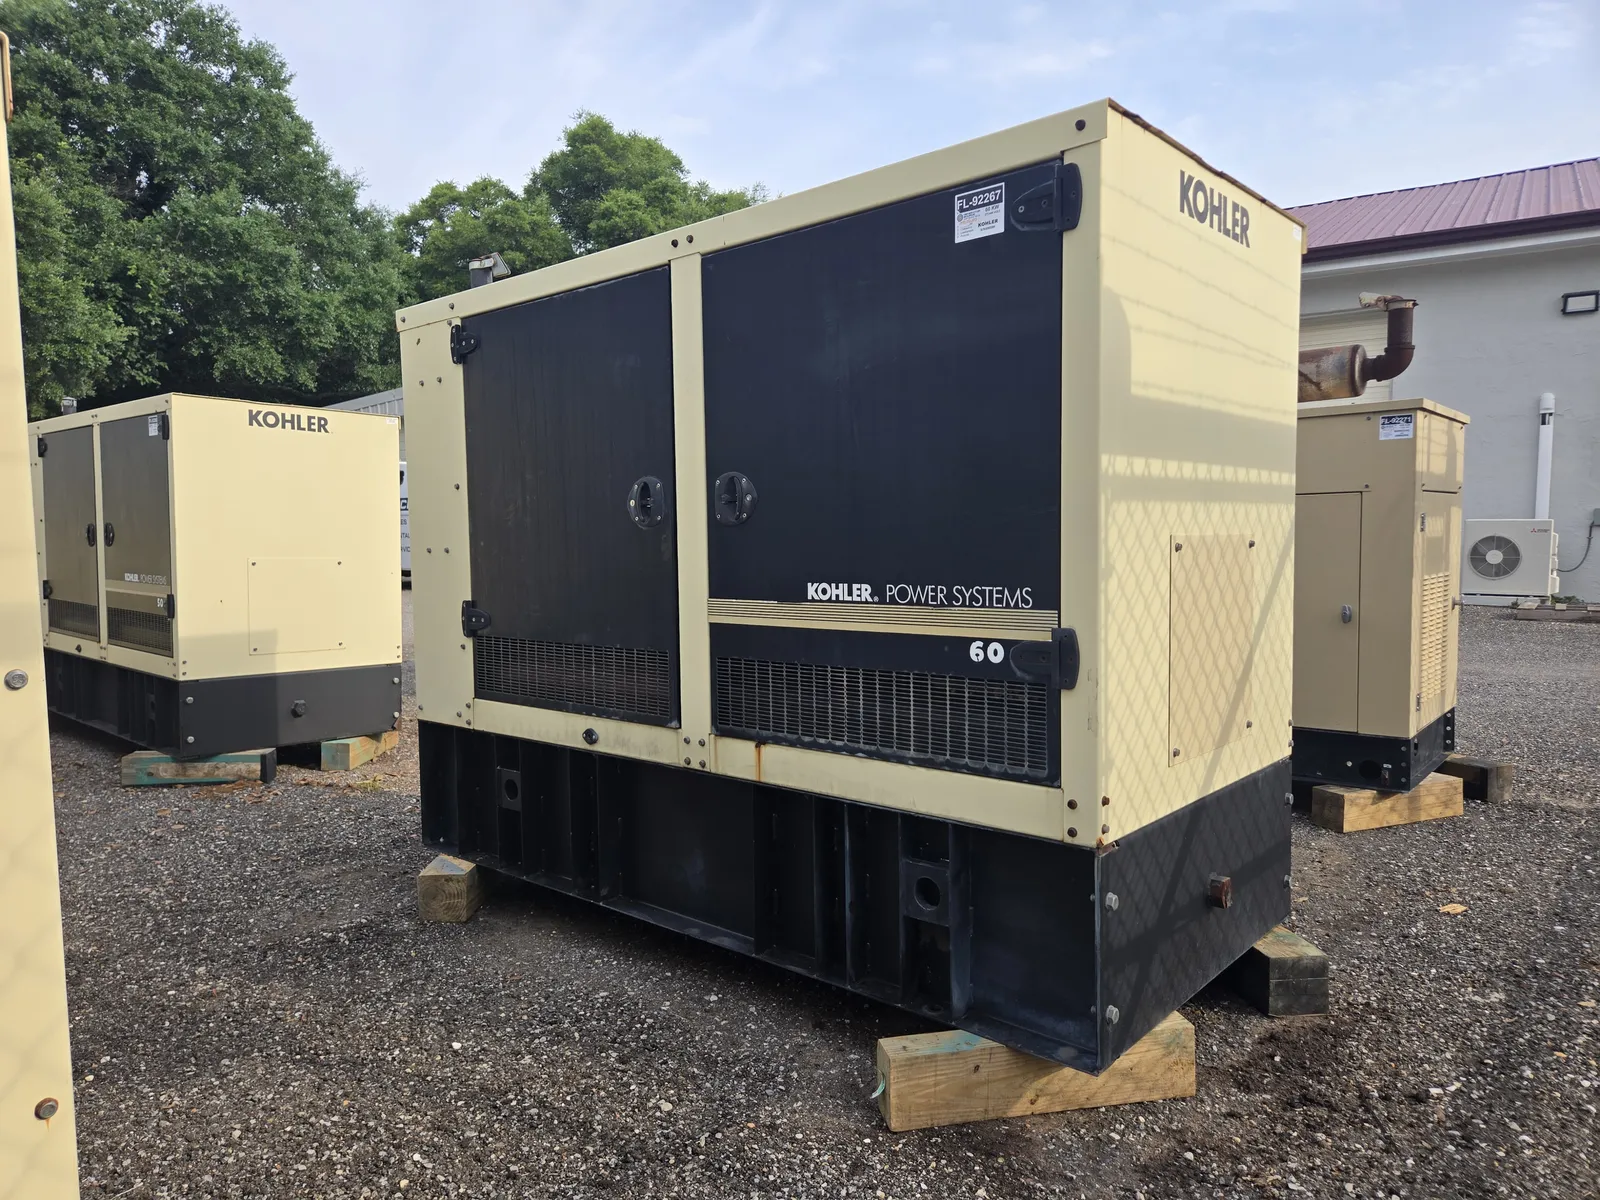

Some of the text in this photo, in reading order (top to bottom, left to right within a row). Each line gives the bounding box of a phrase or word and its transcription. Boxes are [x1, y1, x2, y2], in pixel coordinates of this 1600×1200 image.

[957, 189, 1002, 210] FL-92267
[1179, 168, 1251, 248] KOHLER
[978, 218, 998, 228] KOHLER
[248, 409, 330, 434] KOHLER
[807, 582, 1033, 608] KOHLER POWER SYSTEMS
[969, 641, 1005, 664] 60
